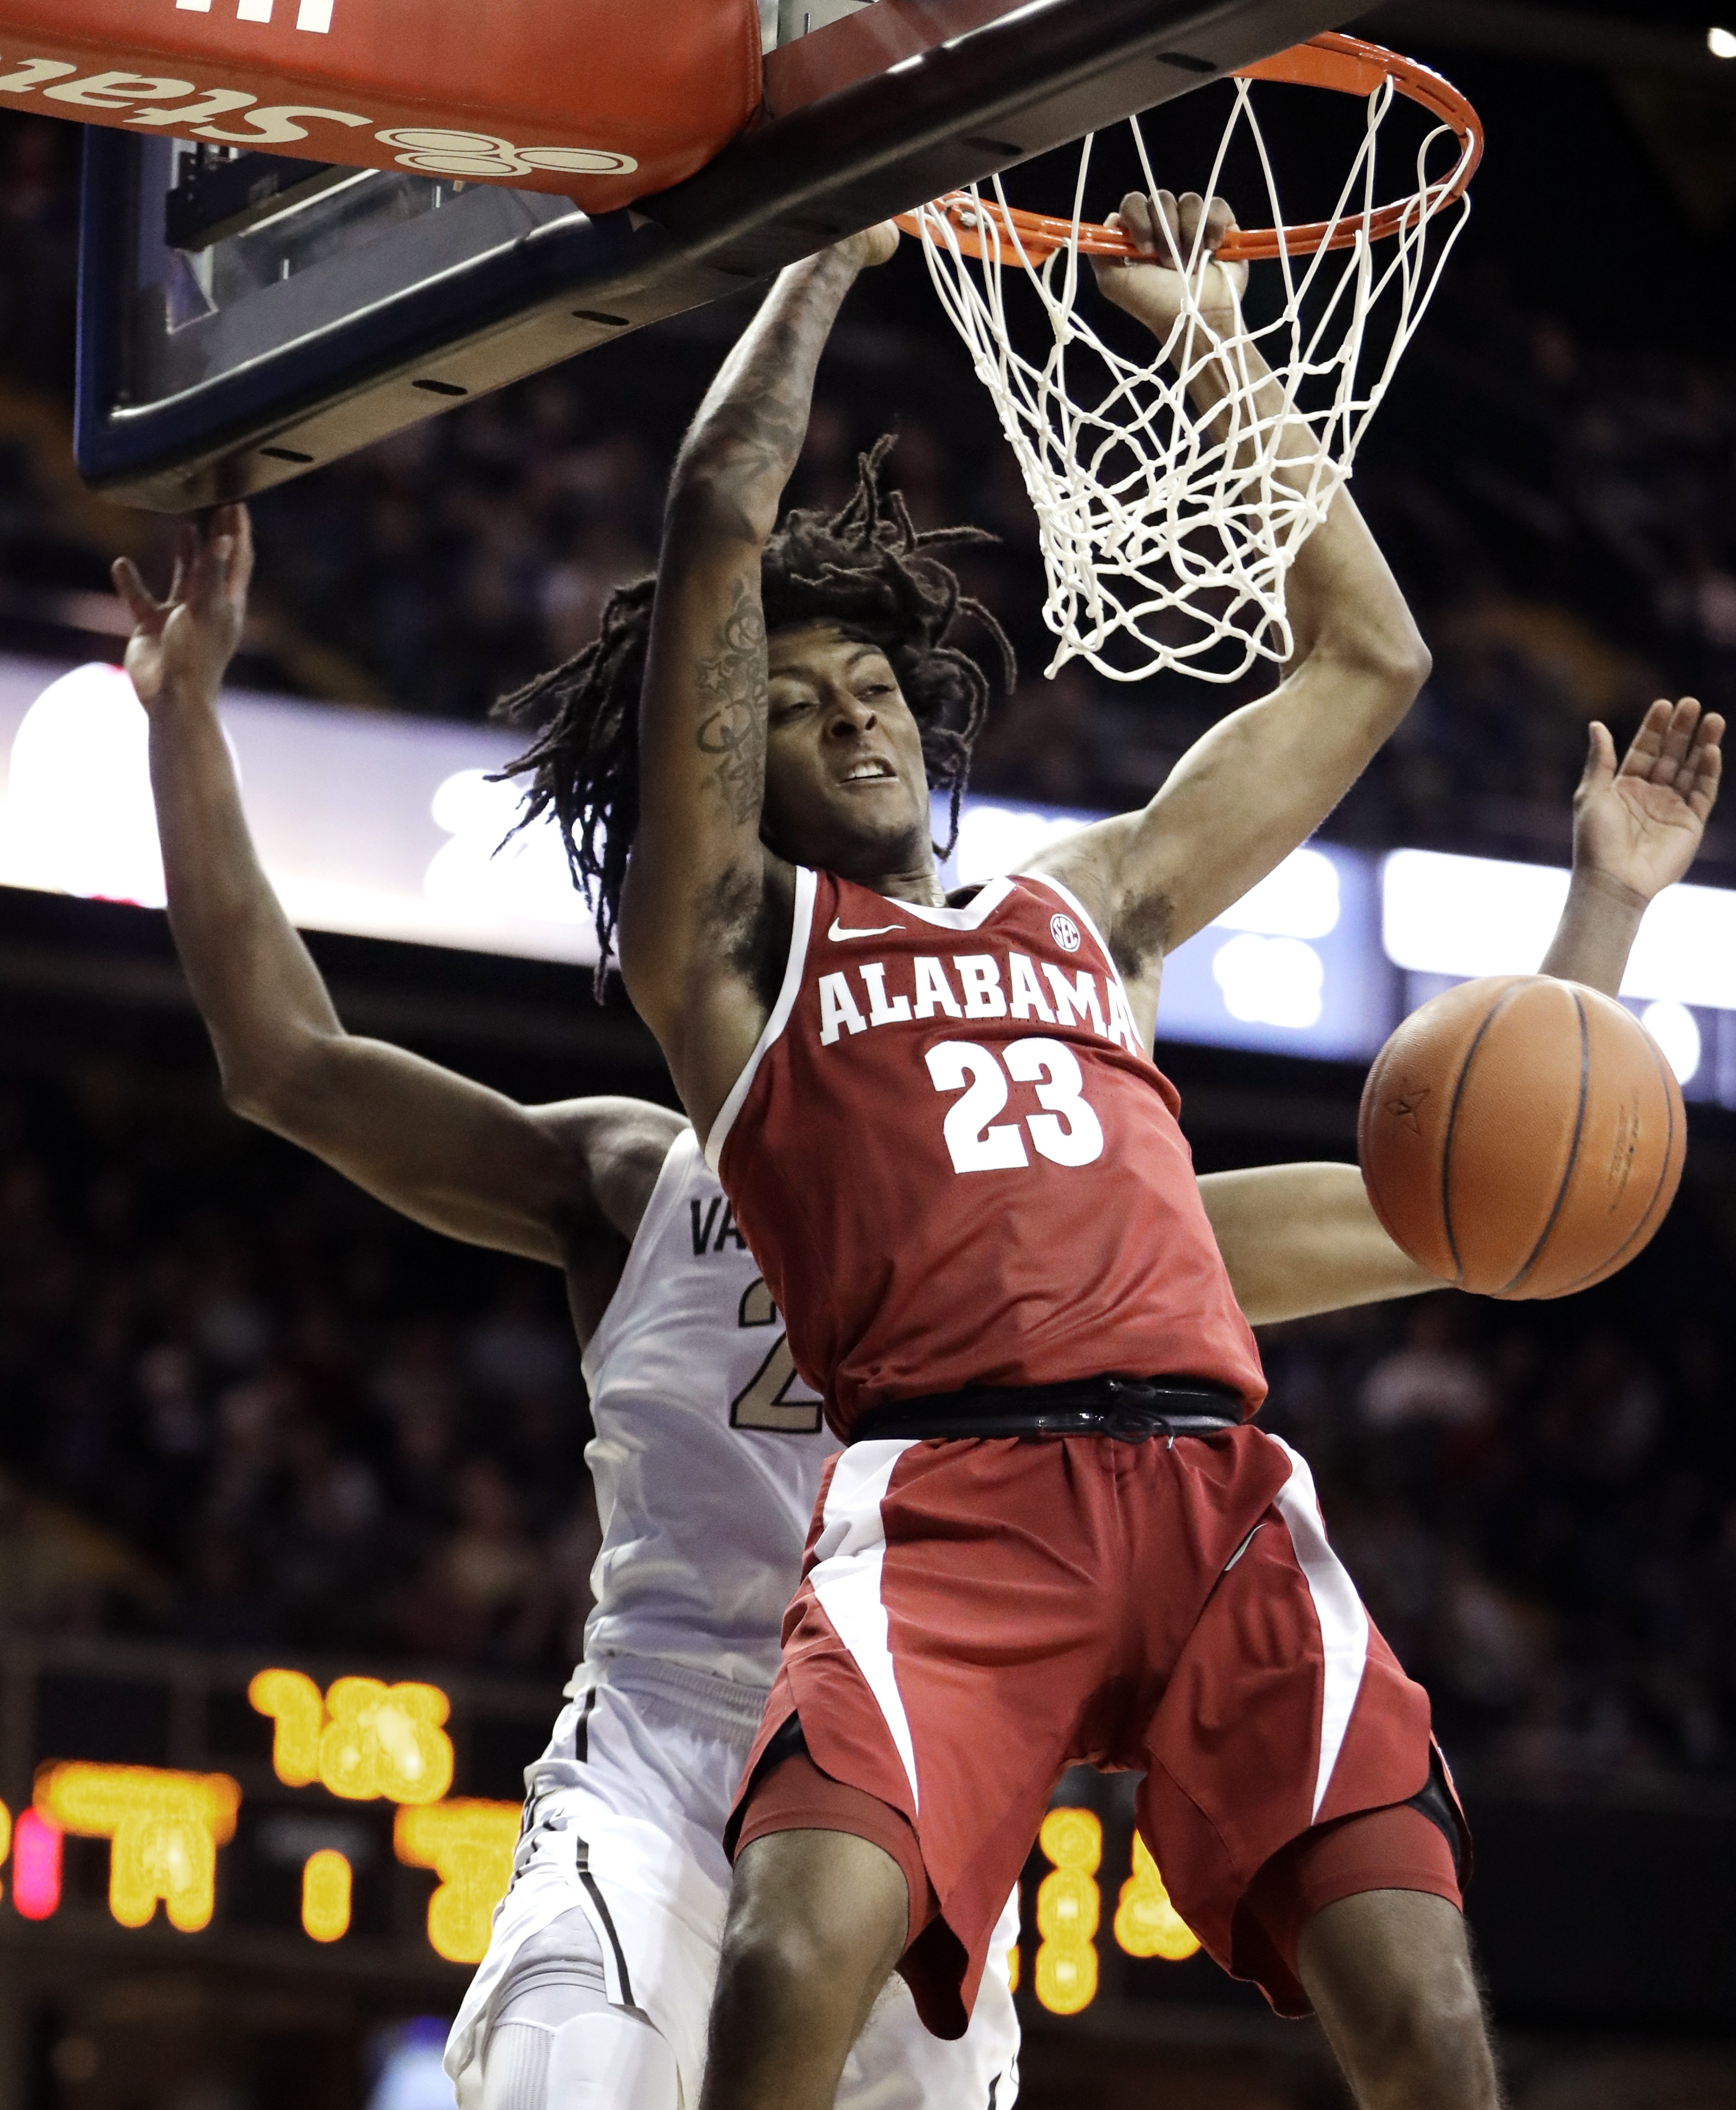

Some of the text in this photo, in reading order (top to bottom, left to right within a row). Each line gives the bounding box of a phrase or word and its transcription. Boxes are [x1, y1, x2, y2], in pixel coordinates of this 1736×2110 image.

[0, 55, 372, 144] Stat
[1053, 917, 1078, 949] SEC
[818, 951, 1137, 1057] ALABAMA
[925, 1037, 1104, 1174] 23
